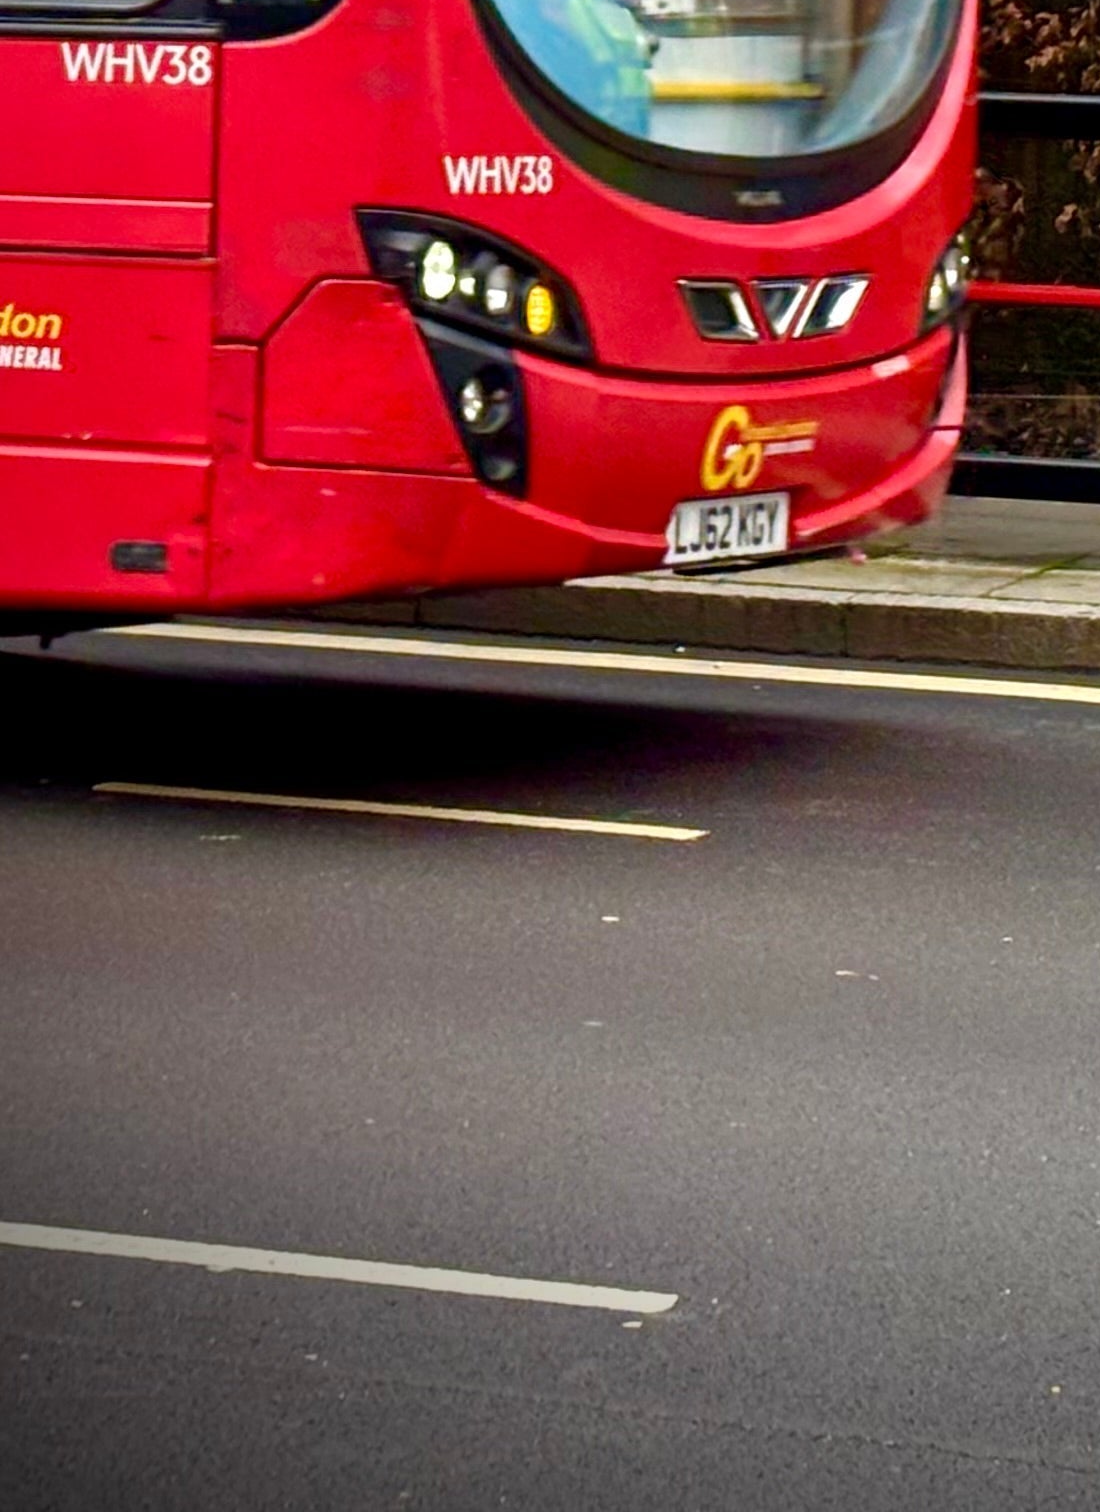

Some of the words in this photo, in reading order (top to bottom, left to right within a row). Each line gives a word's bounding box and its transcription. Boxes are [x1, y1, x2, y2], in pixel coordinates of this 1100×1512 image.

[61, 43, 212, 86] WHV38
[443, 155, 553, 195] WHV38
[0, 345, 63, 371] NERAL
